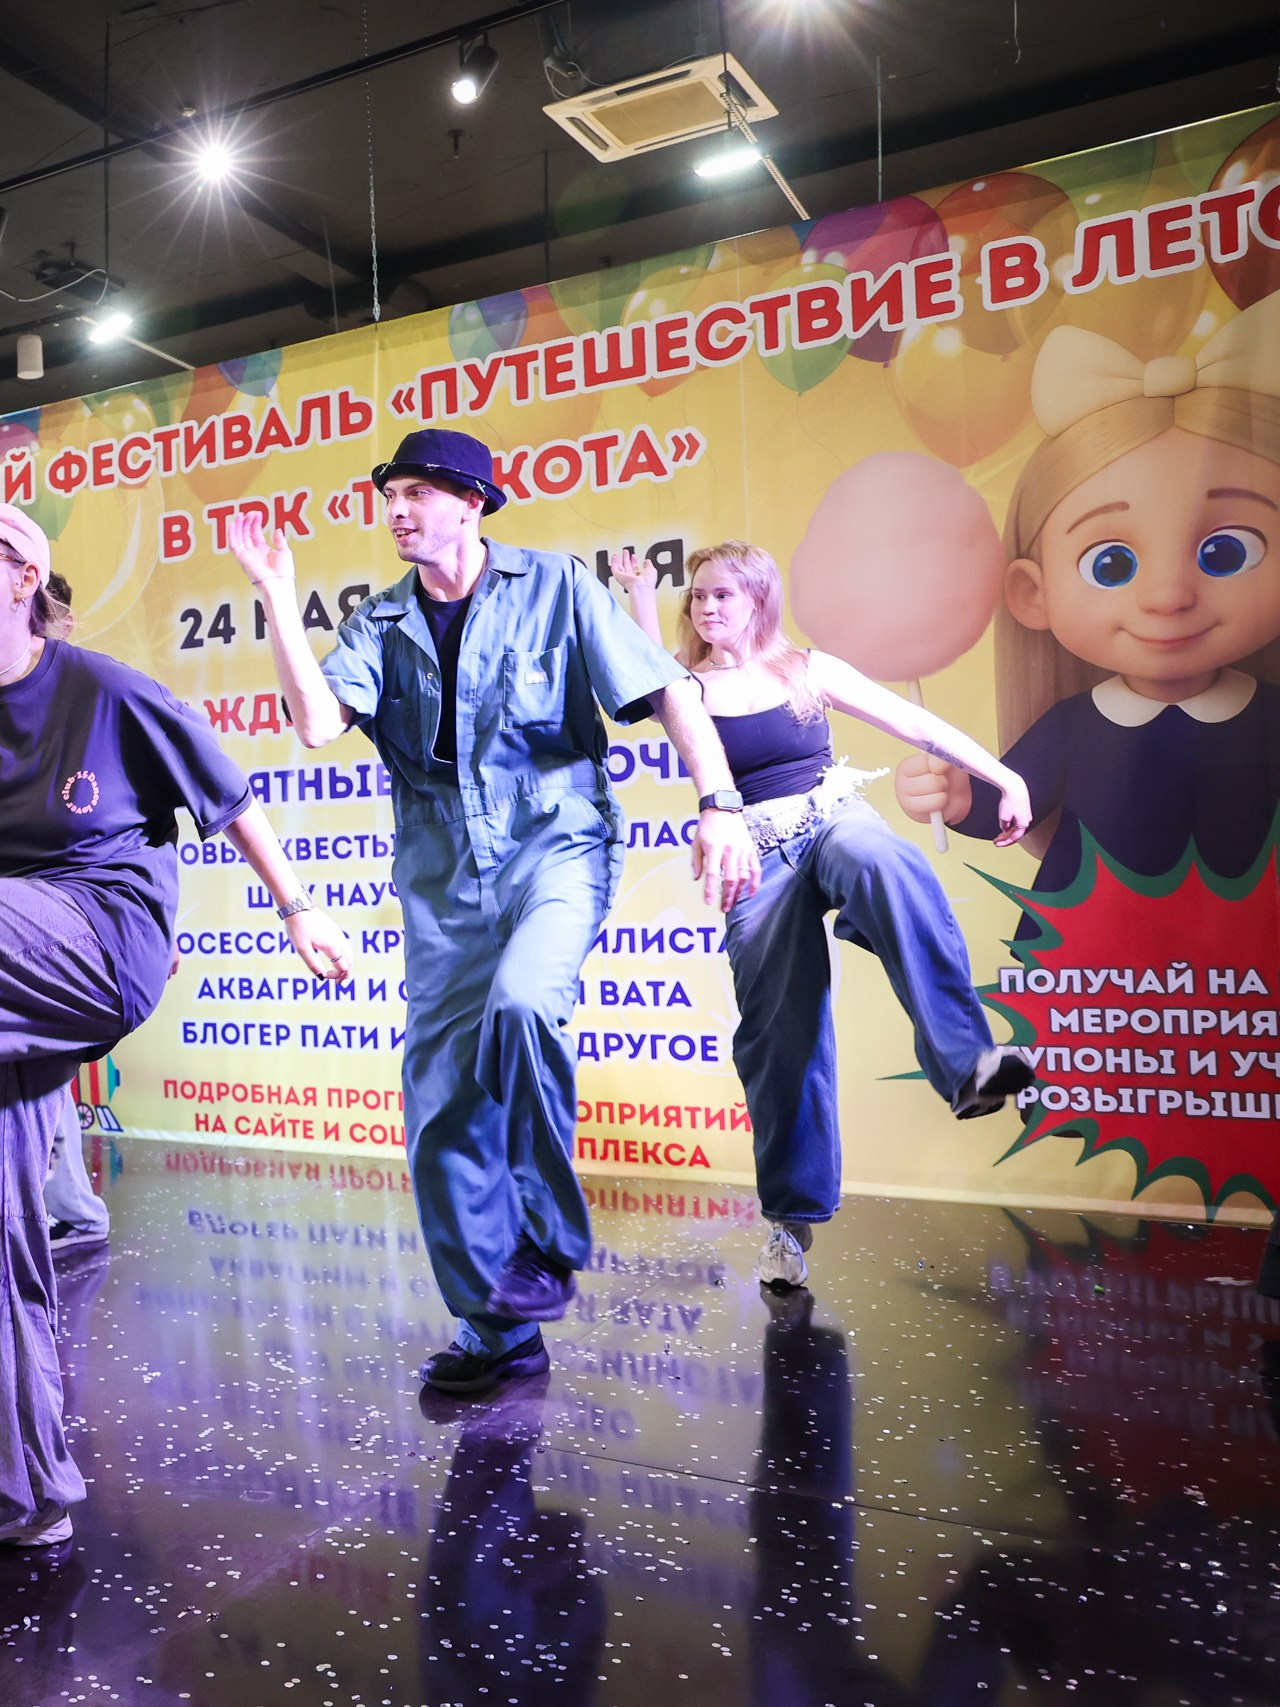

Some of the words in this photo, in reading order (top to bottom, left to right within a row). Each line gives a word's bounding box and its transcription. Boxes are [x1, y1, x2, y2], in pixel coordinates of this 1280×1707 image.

[49, 397, 373, 493] ФЕСТИВАЛЬ
[391, 258, 956, 418] «ПУТЕШЕСТВИЕ
[989, 243, 1041, 304] В
[163, 515, 191, 558] В
[180, 603, 237, 650] 24
[198, 978, 356, 1001] АКВАГРИМ
[368, 979, 387, 1001] И
[600, 980, 692, 1007] ВАТА
[1000, 962, 1194, 994] ПОЛУЧАЙ
[1209, 968, 1268, 994] НА
[182, 1021, 291, 1046] БЛОГЕР
[301, 1025, 379, 1049] ПАТИ
[578, 1032, 718, 1062] ДРУГОЕ
[1050, 1008, 1280, 1036] МЕРОПРИЯ
[997, 1046, 1176, 1075] УПОНЫ
[1190, 1050, 1217, 1076] И
[1231, 1051, 1280, 1078] УЧ
[163, 1079, 317, 1107] ПОДРОБНАЯ
[577, 1100, 754, 1132] ОПРИЯТИЙ
[1017, 1085, 1280, 1119] РОЗЫГРЫШ
[195, 1113, 227, 1133] НА
[234, 1112, 314, 1140] САЙТЕ
[324, 1121, 340, 1141] И
[573, 1137, 711, 1168] ПЛЕКСА
